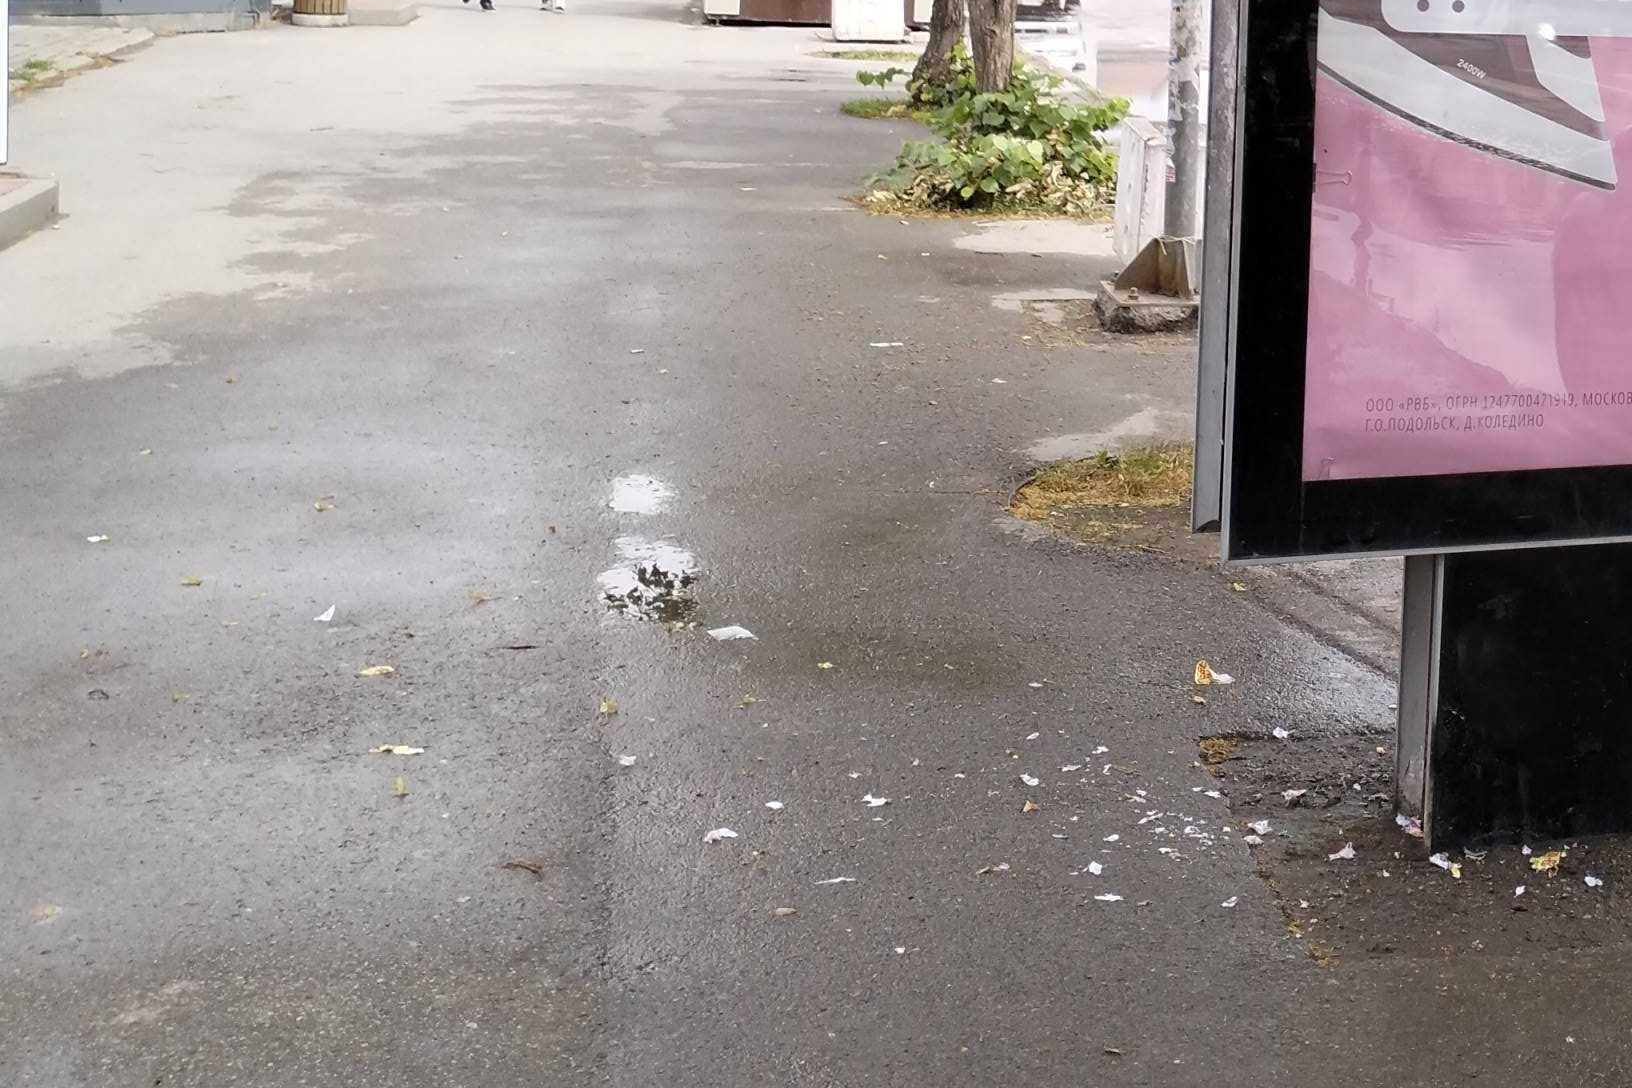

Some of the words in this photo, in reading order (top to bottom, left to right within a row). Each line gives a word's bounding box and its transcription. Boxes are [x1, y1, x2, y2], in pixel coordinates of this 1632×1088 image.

[1456, 58, 1487, 79] 2400W
[1365, 398, 1394, 412] ООО
[1446, 395, 1478, 409] ОГРН
